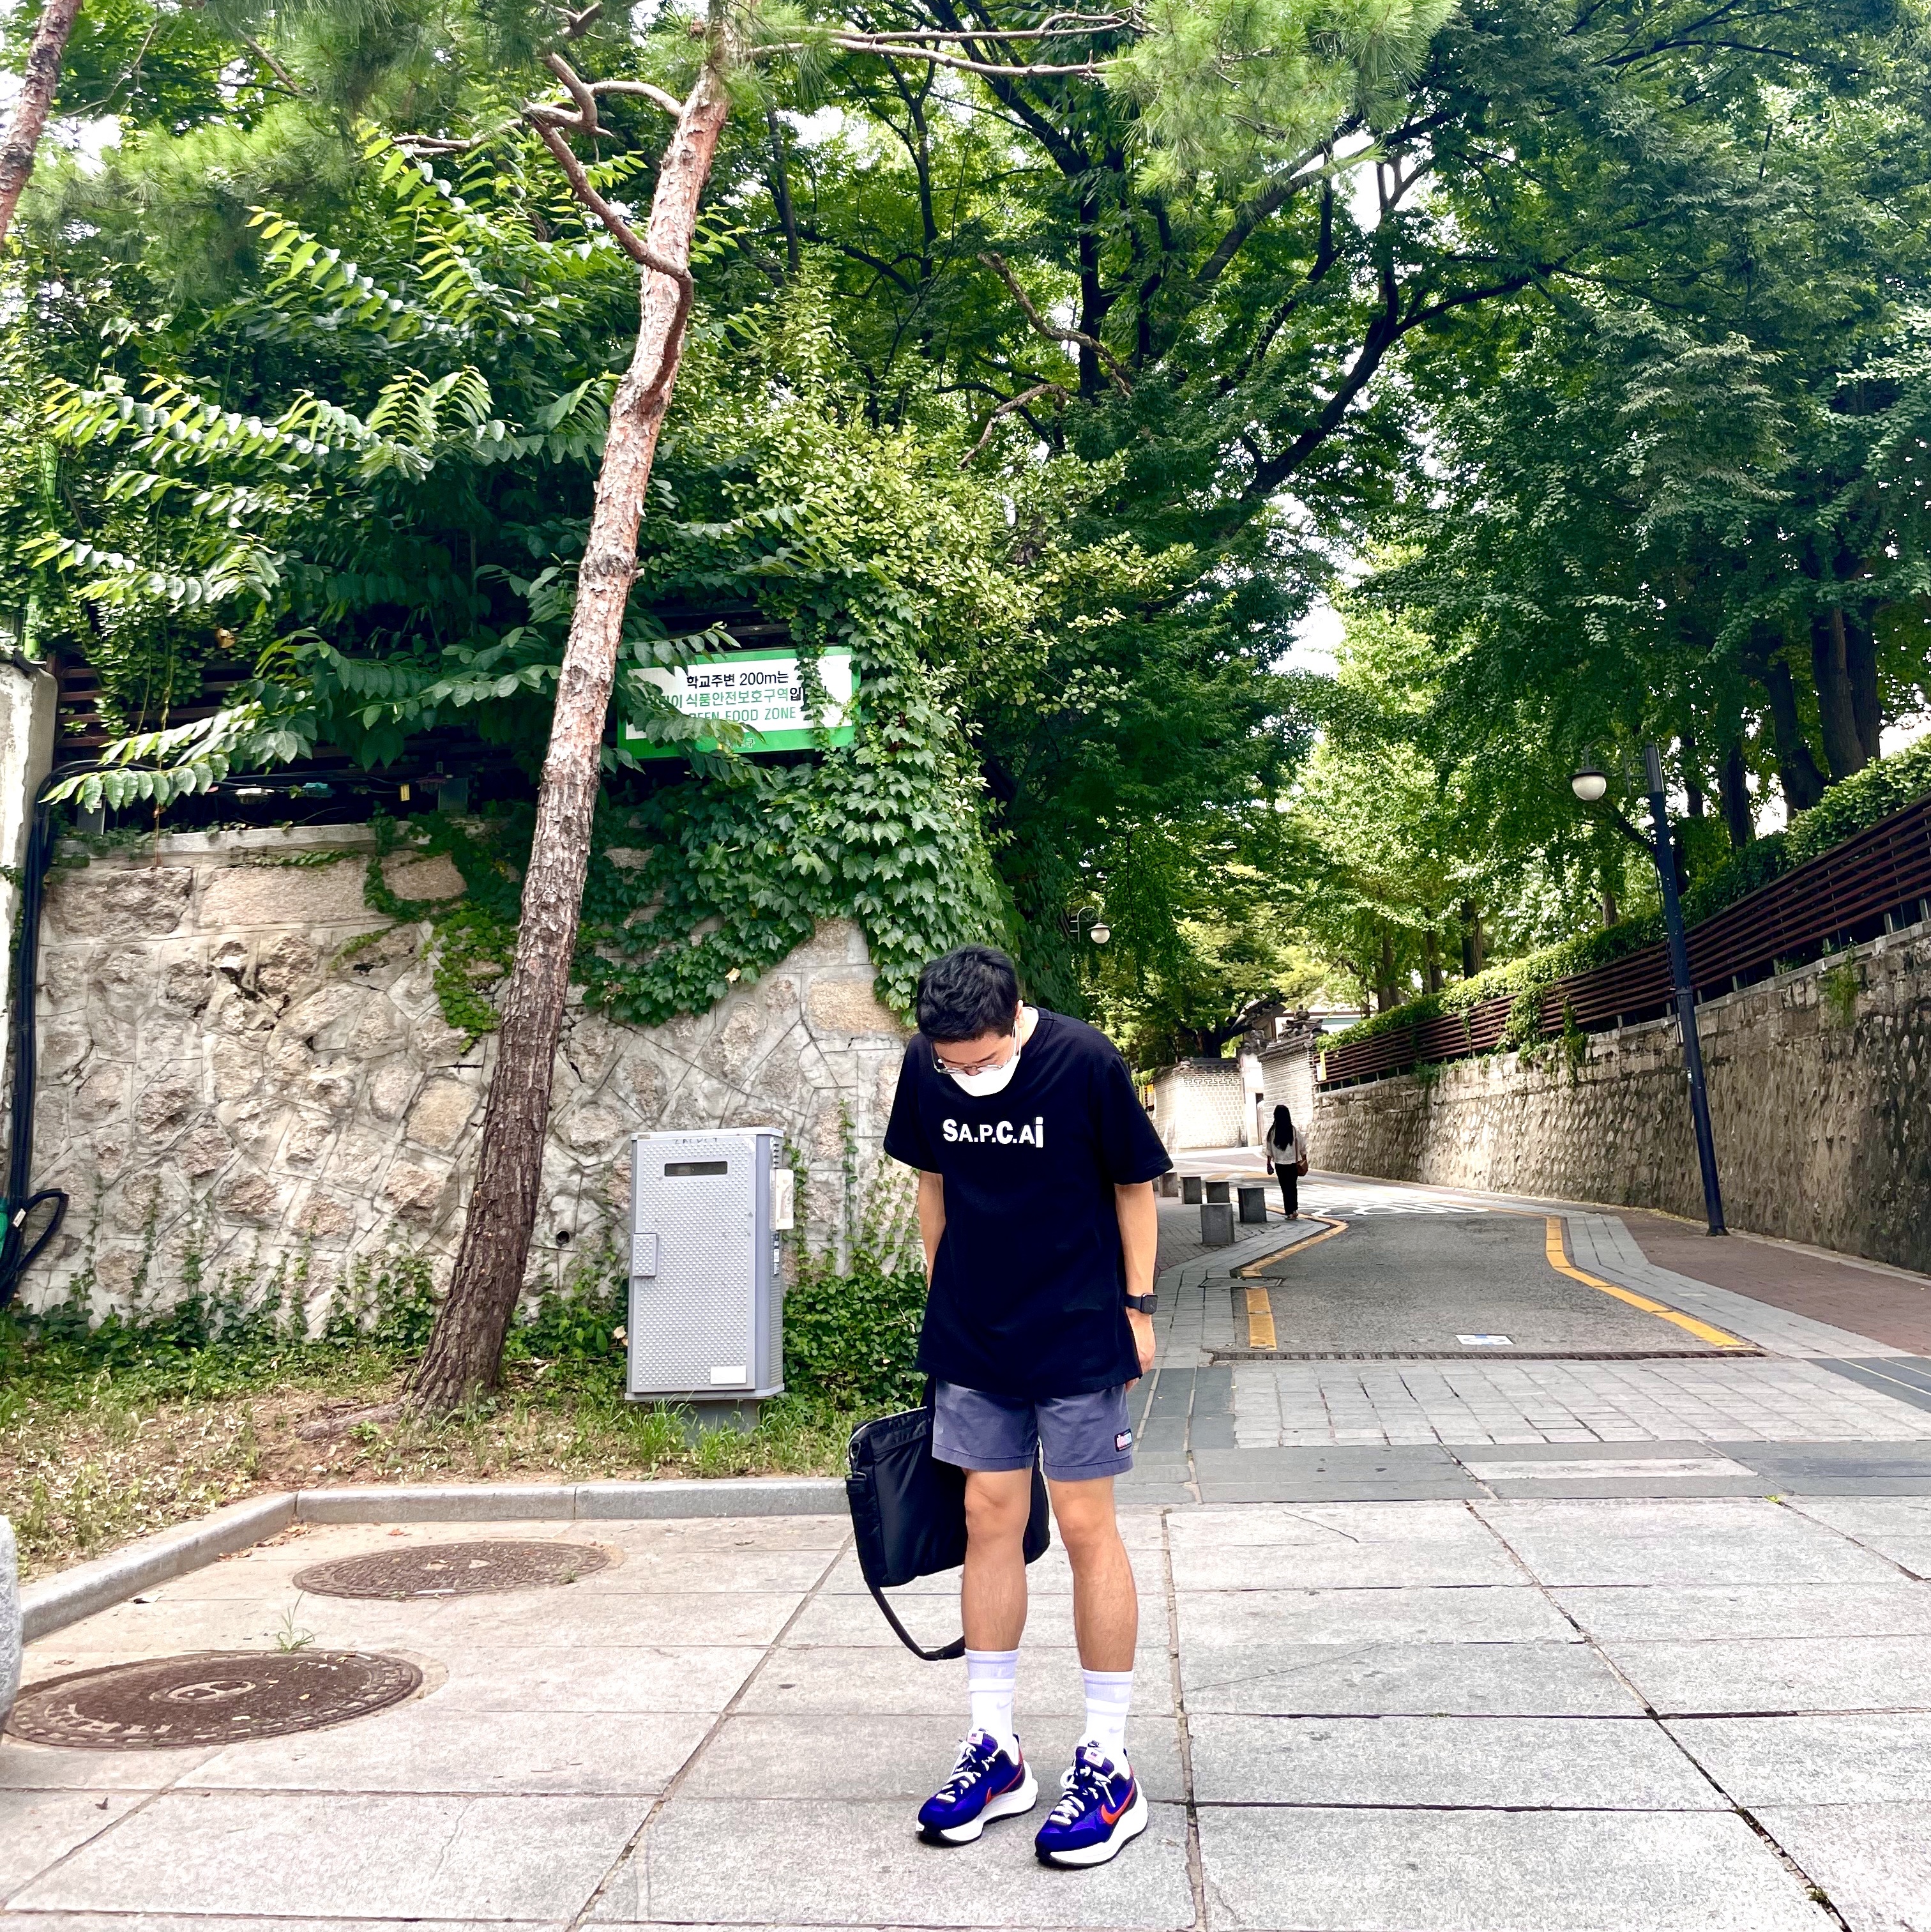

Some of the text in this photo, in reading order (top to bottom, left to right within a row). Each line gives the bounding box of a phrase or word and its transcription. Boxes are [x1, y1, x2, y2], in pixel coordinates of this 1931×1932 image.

[686, 671, 789, 689] 학교주변 200m는
[725, 709, 759, 722] FOOD
[764, 706, 797, 720] ZONE
